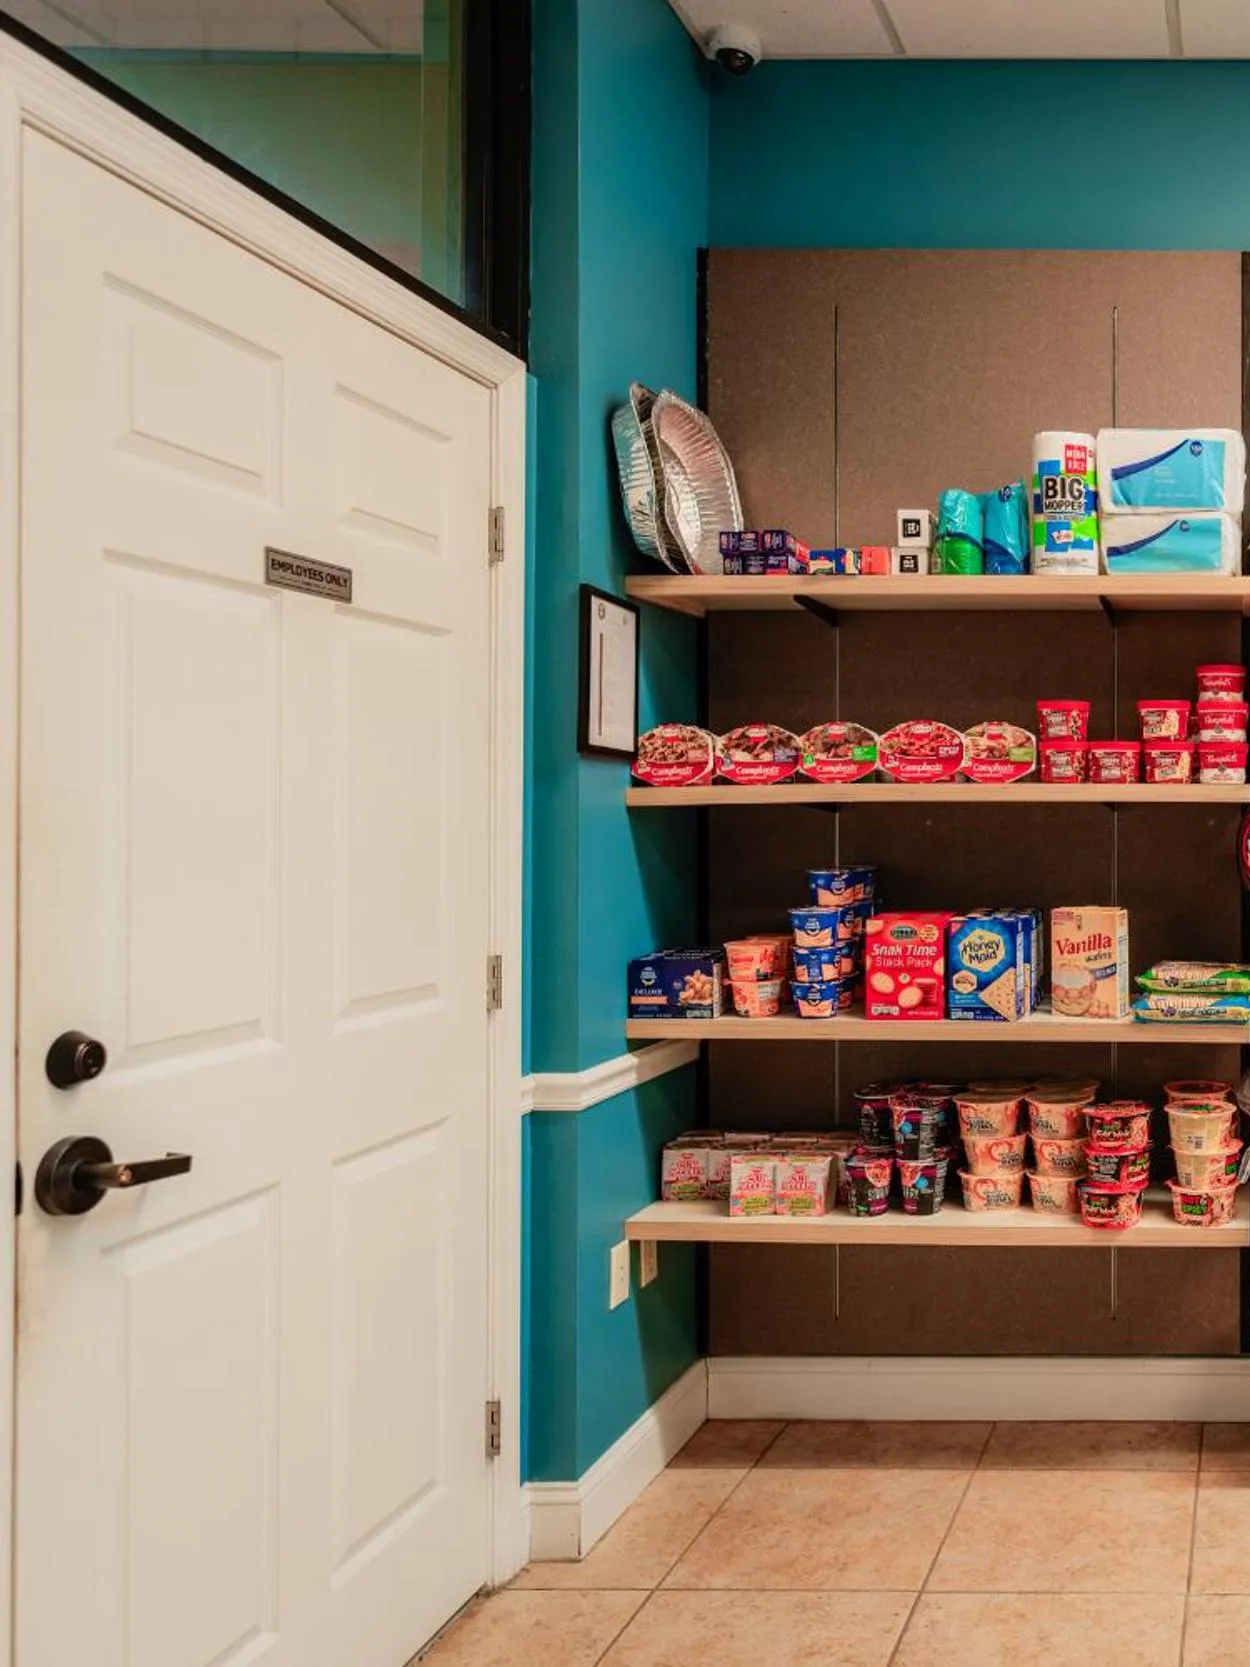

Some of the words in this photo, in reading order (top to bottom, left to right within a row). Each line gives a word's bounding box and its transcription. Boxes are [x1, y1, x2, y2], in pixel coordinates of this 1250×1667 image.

[1045, 477, 1083, 500] BIG
[1045, 500, 1083, 511] MOPPER
[271, 558, 324, 582] EMPLOYEES
[325, 572, 348, 588] ONLY
[906, 944, 937, 956] Time
[961, 938, 1001, 956] Honey
[1056, 933, 1112, 956] Vanilla
[907, 957, 933, 968] Pack
[969, 950, 998, 965] Maid
